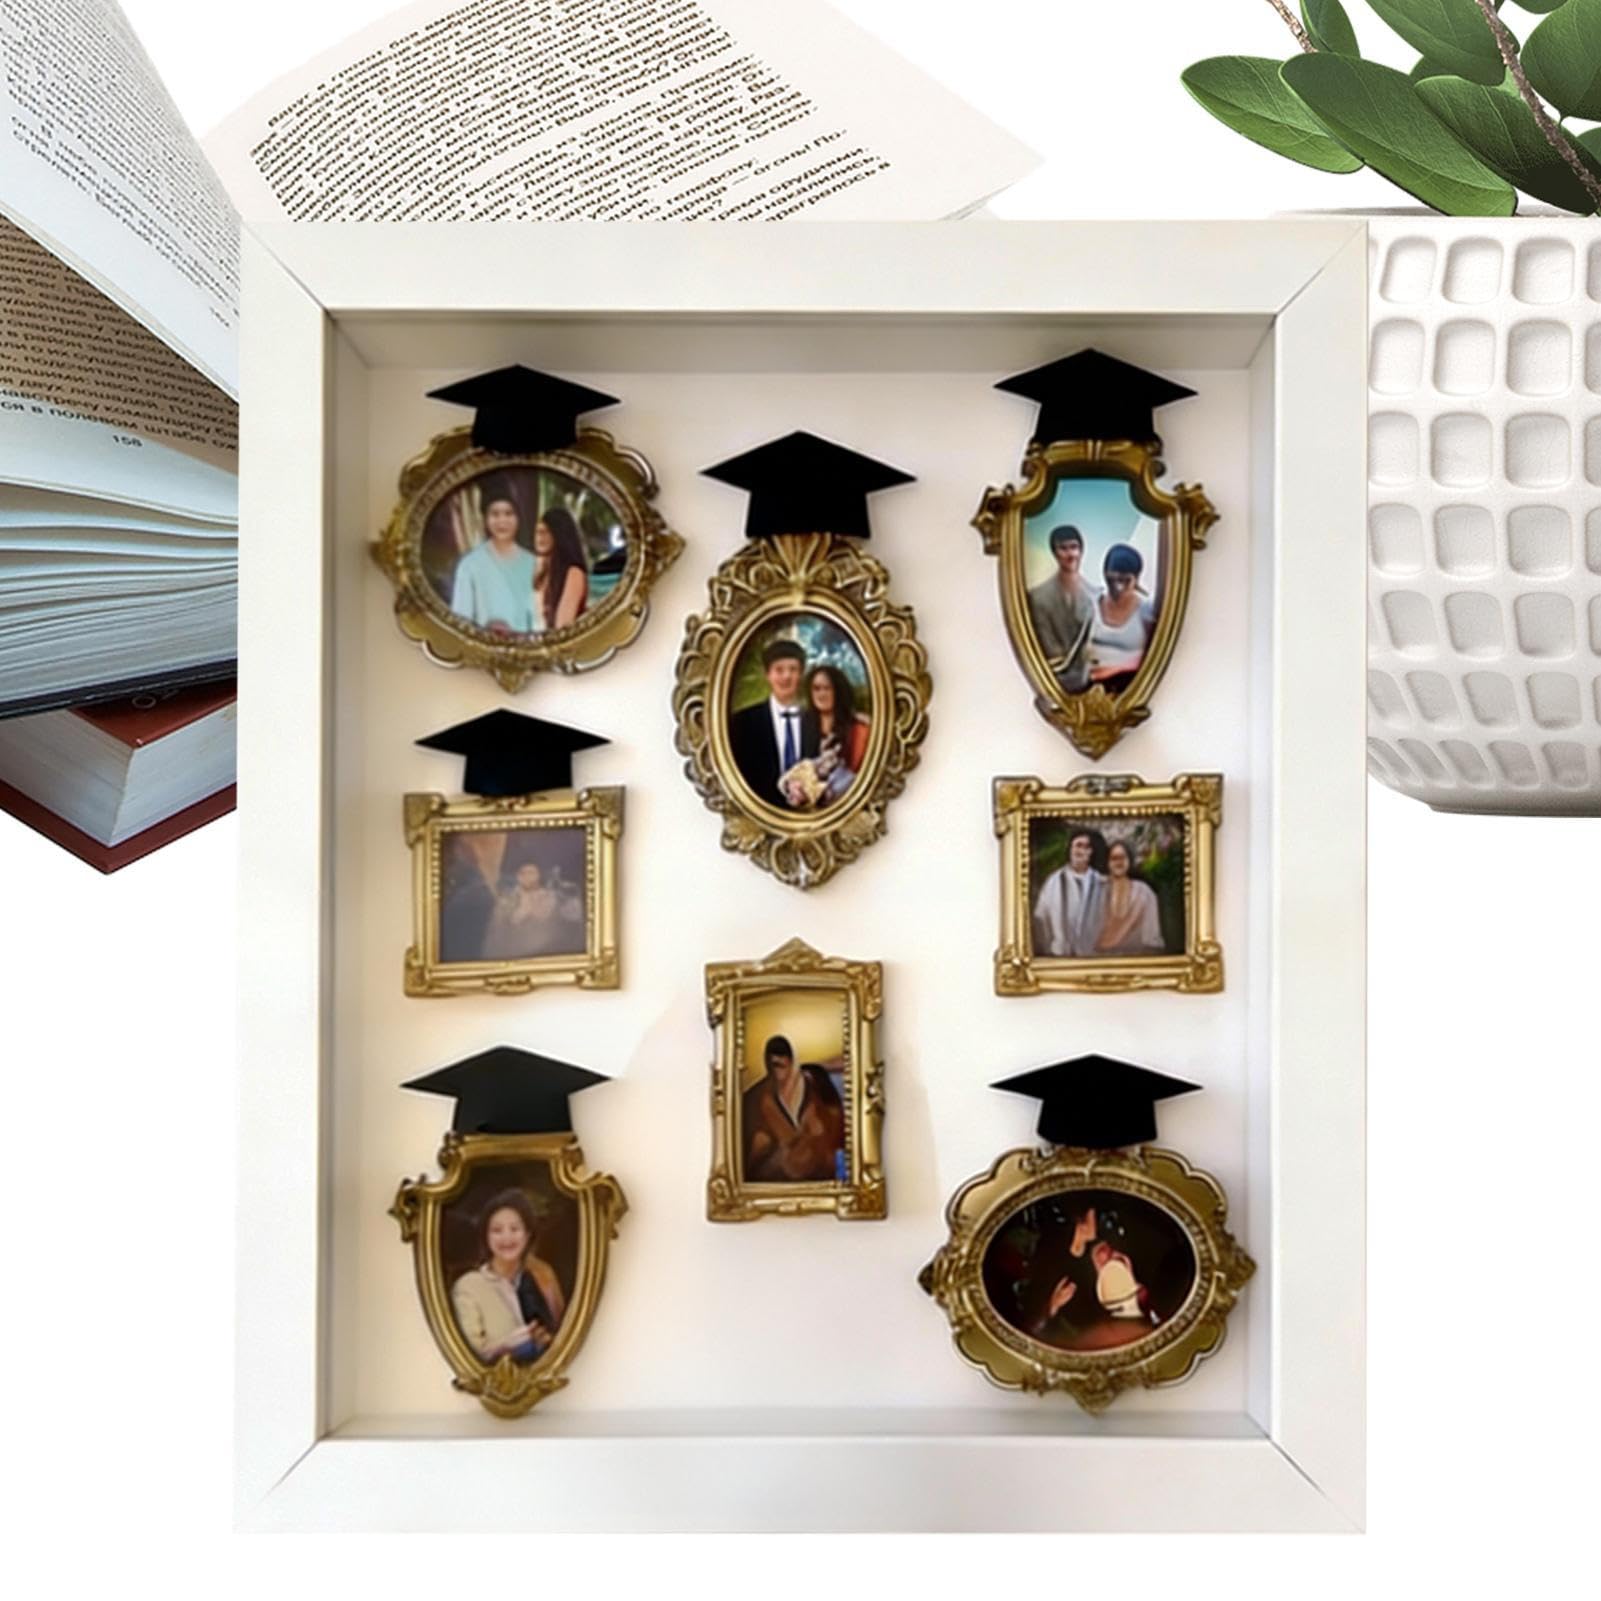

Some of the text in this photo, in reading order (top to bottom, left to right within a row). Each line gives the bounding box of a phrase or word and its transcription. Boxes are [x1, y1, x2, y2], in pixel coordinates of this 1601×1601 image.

[570, 36, 620, 63] рукой
[615, 17, 712, 65] телефонист
[674, 32, 730, 62] Огонь!
[474, 74, 495, 87] по
[580, 64, 639, 93] приказ
[555, 99, 616, 126] Видно,
[656, 85, 734, 124] Выстрел.
[582, 142, 670, 185] зловещую
[655, 186, 728, 221] наряда
[754, 144, 812, 177] огонь!
[813, 129, 847, 147] По-
[49, 408, 139, 430] полевом
[144, 425, 207, 444] штабе
